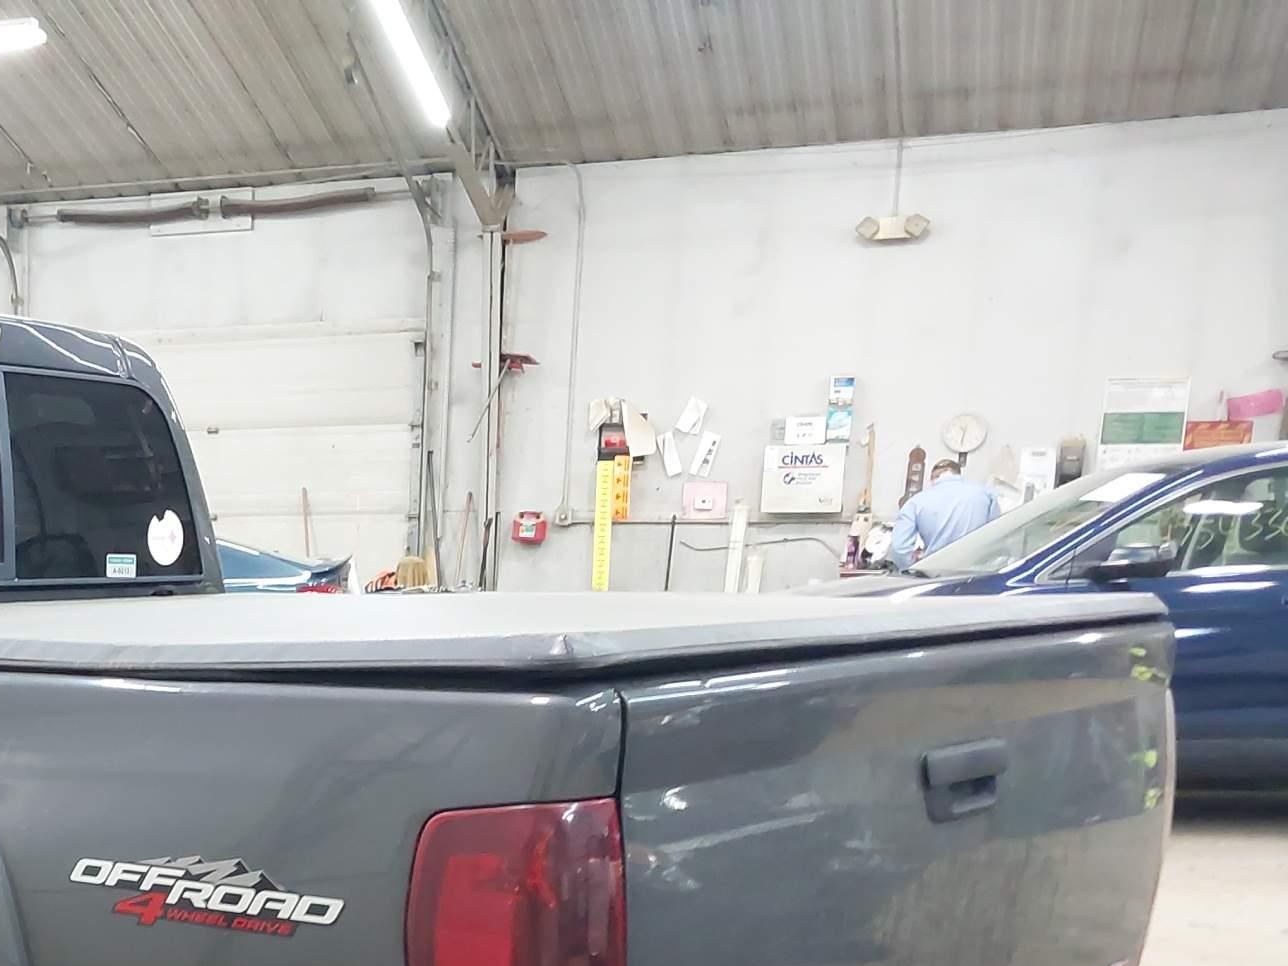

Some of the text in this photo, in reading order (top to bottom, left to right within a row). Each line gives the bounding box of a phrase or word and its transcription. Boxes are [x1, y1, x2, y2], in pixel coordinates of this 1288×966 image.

[781, 451, 824, 466] CINTAS
[114, 890, 296, 936] 4 WHEEL DRIVE
